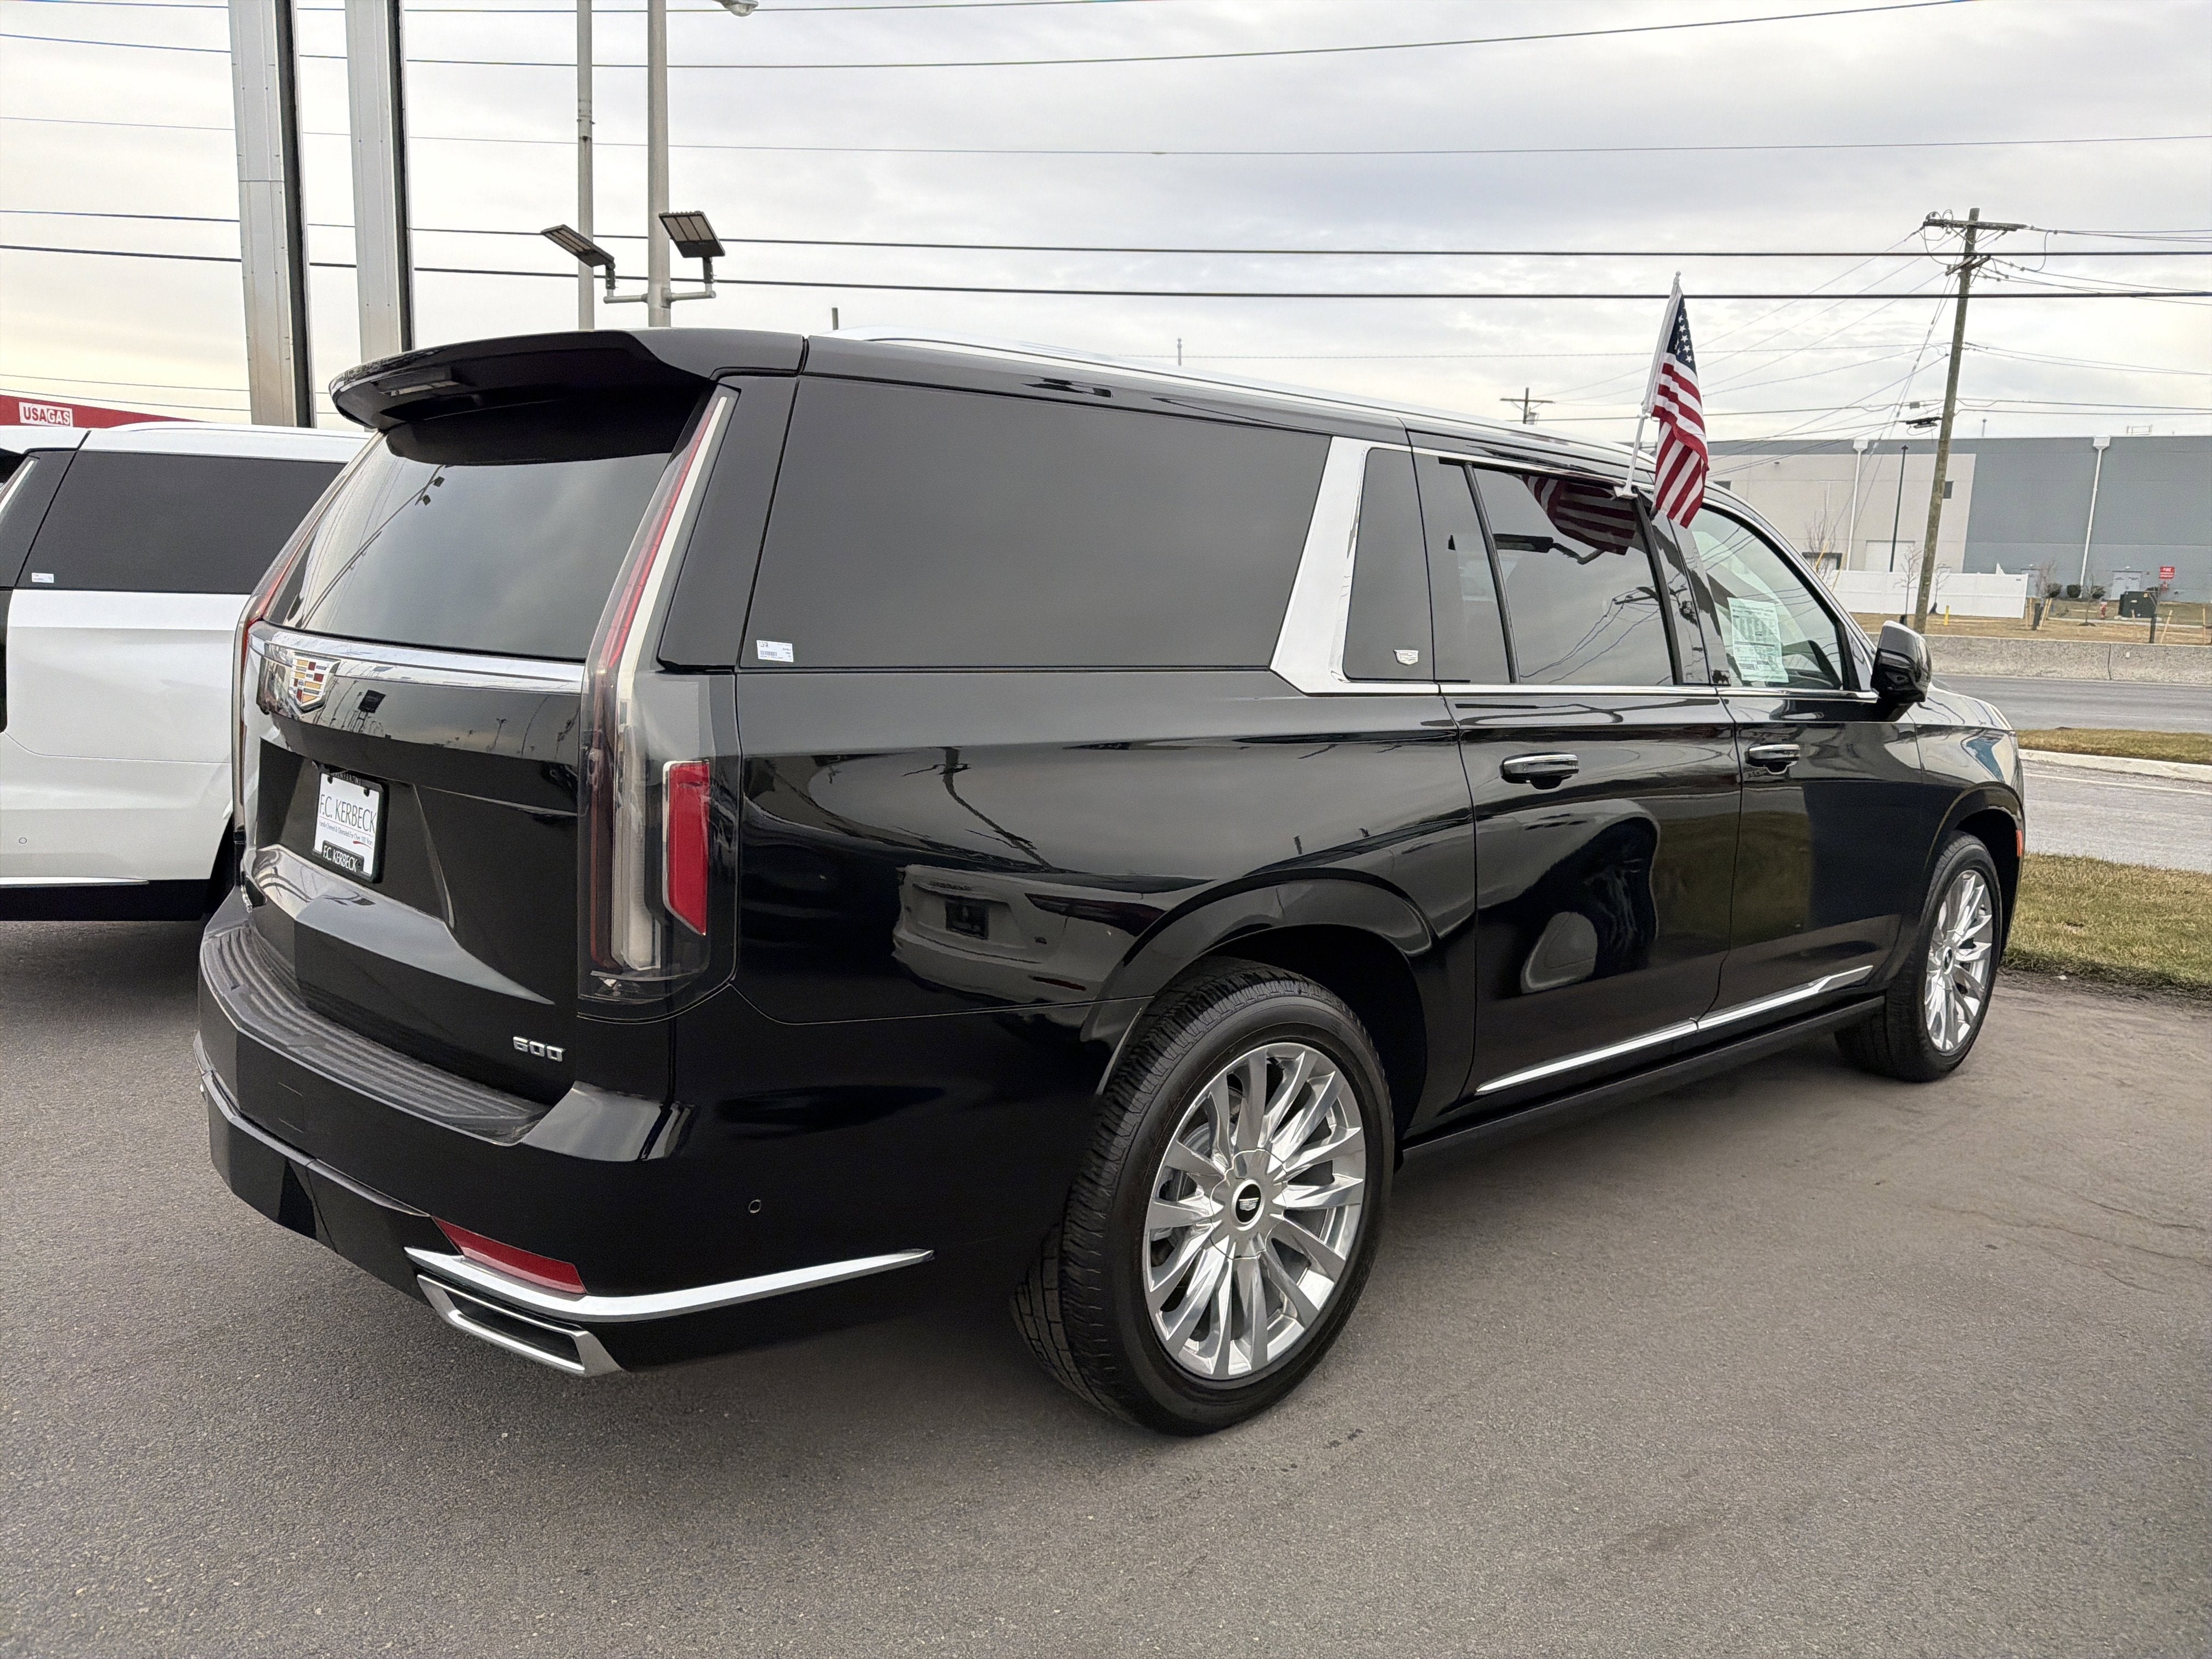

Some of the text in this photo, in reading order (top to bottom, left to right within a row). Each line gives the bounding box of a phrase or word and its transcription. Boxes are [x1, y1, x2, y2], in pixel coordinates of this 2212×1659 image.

[319, 794, 377, 834] F.C. KERBECK
[323, 845, 358, 872] F.C. KERBECK
[513, 1036, 563, 1062] 600
